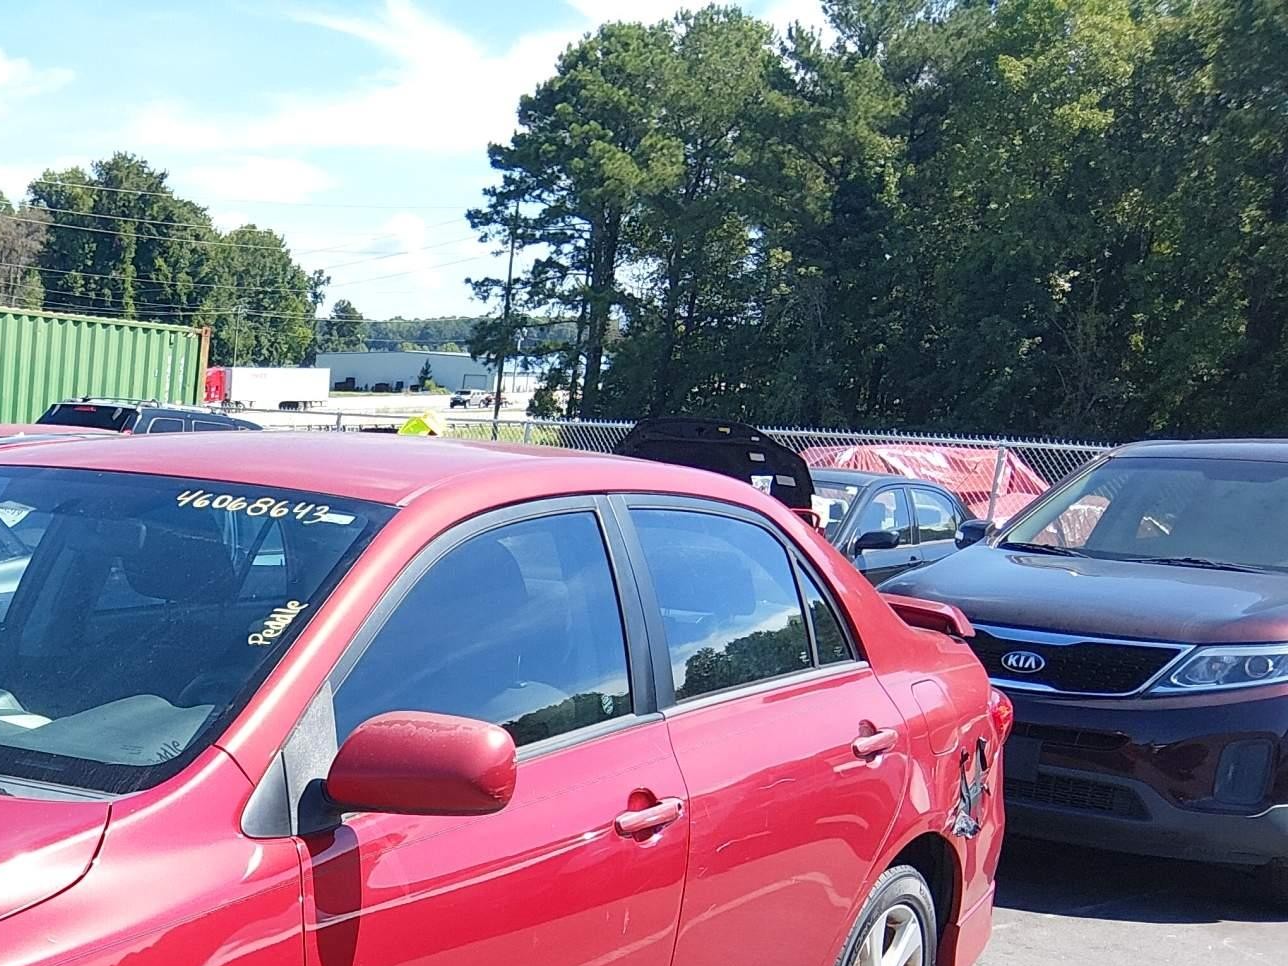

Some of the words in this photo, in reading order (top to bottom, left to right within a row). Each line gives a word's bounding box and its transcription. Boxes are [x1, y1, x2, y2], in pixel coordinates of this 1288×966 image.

[175, 490, 329, 525] 46068643
[247, 600, 310, 647] Peddle
[1007, 654, 1036, 669] KIA
